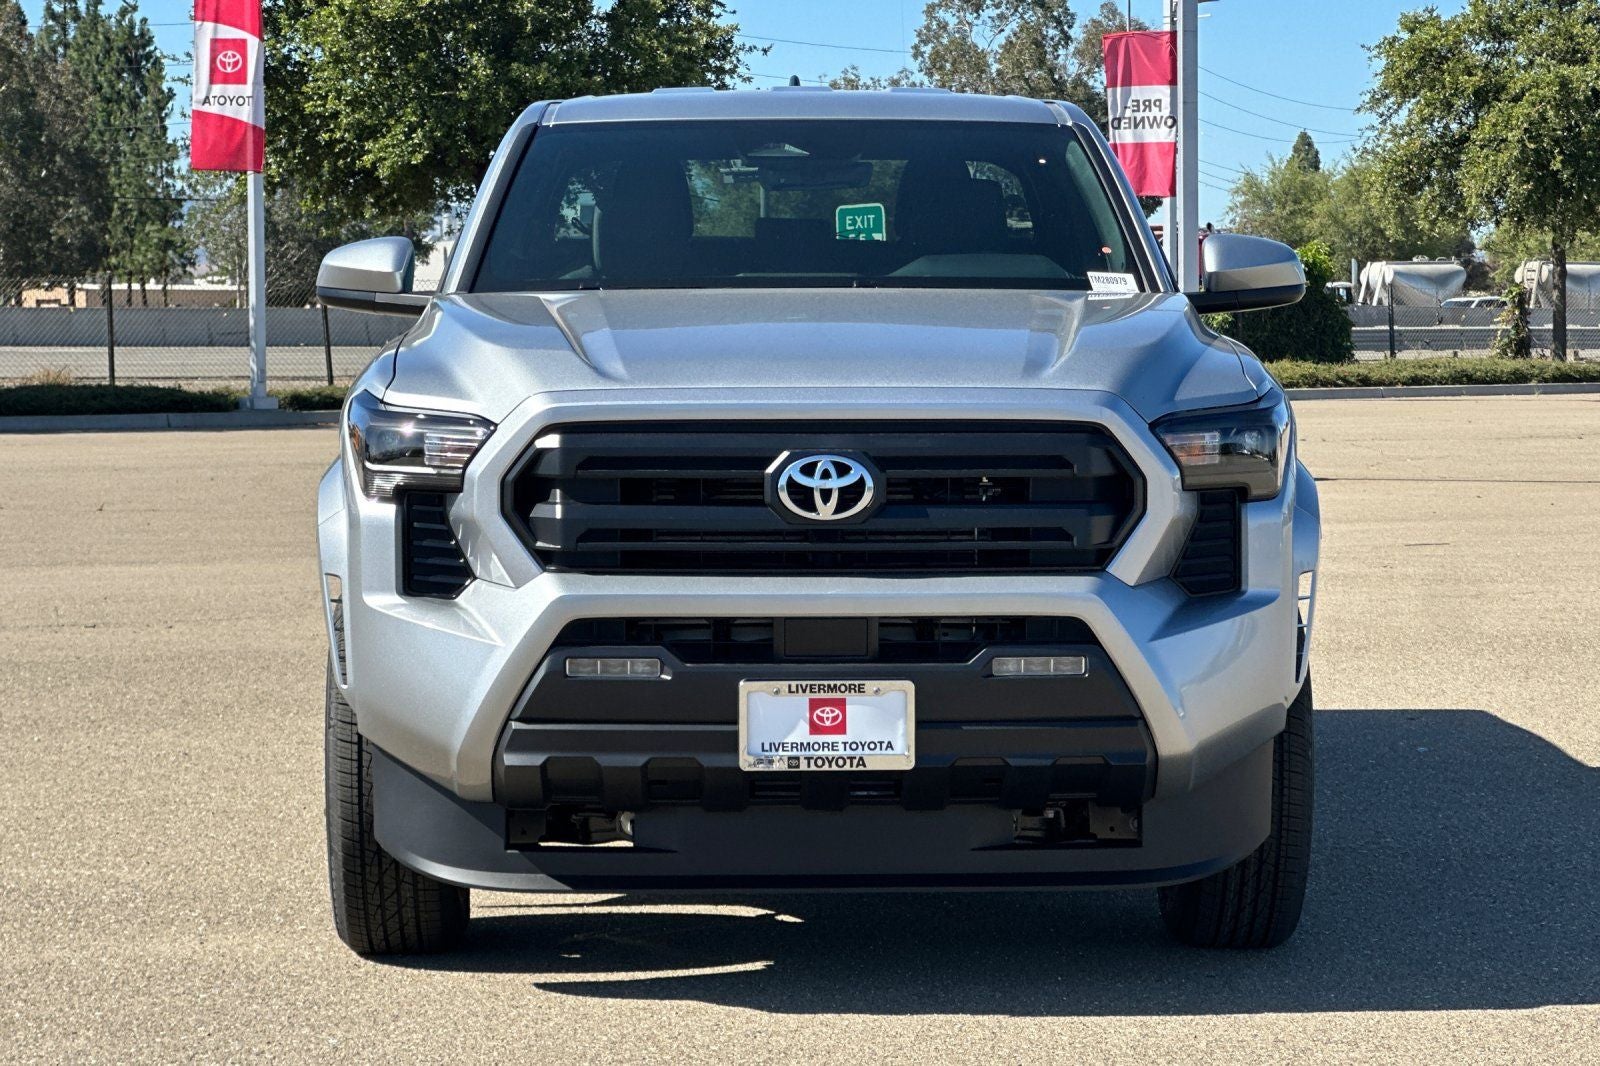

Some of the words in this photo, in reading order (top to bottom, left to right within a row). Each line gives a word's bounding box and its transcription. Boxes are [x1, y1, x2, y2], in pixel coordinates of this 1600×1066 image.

[846, 215, 875, 230] EXIT
[787, 683, 866, 694] LIVERMORE
[761, 741, 839, 752] LIVERMORE
[841, 740, 894, 751] TOYOTA
[804, 756, 867, 768] TOYOTA
